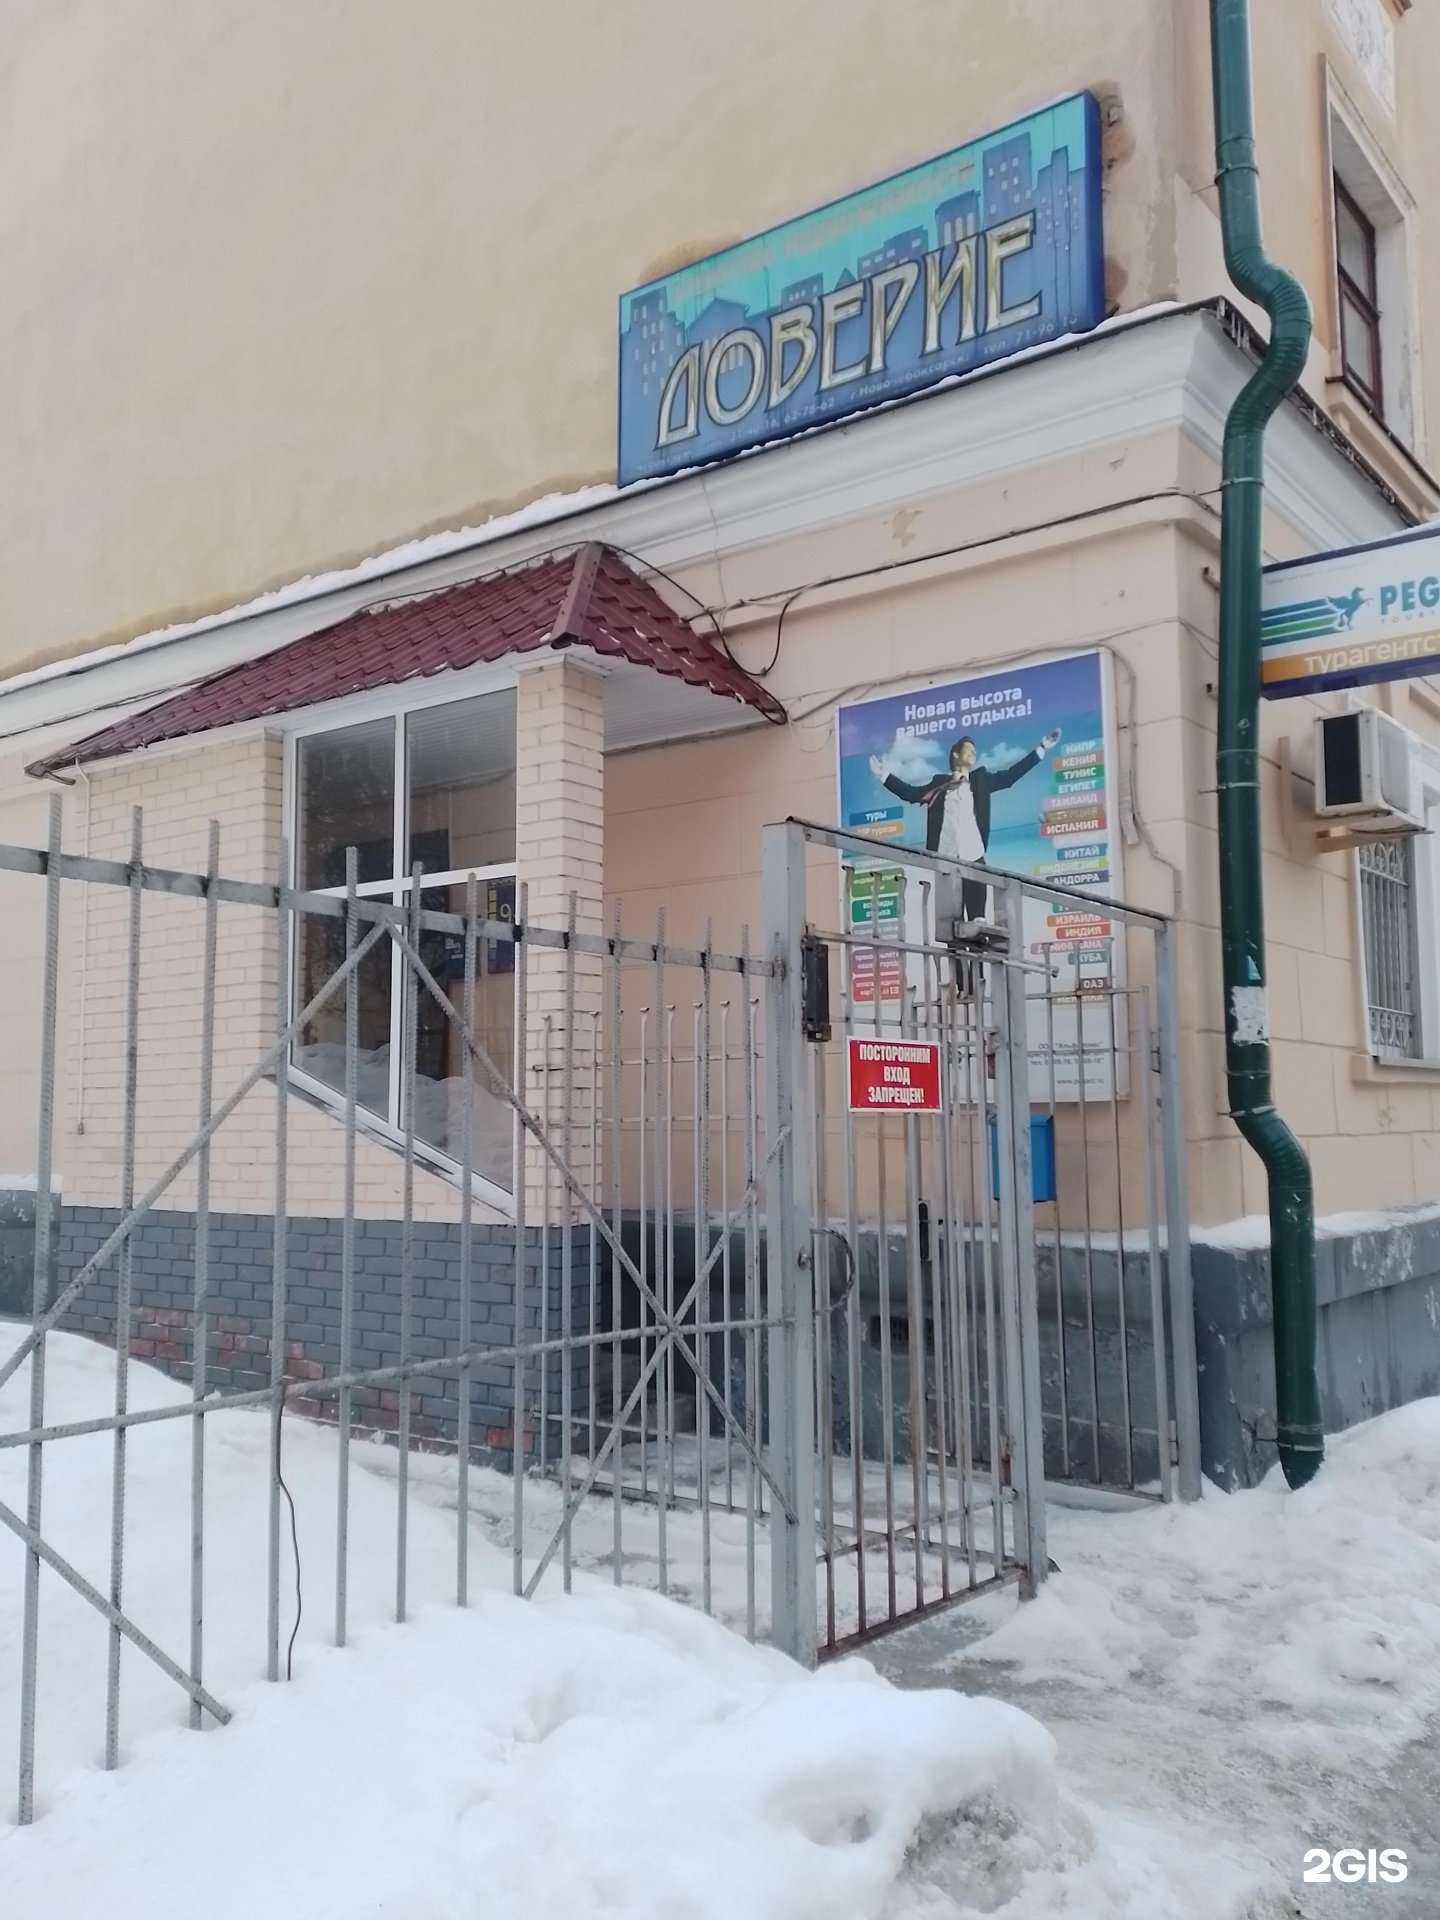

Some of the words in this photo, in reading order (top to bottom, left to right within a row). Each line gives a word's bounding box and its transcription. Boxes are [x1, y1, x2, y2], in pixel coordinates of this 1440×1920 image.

[654, 208, 1042, 451] ДОВЕРИЕ
[904, 700, 956, 721] Новая
[961, 687, 1022, 711] высота
[896, 717, 956, 740] вашего
[961, 698, 1033, 727] отдыха!
[1062, 753, 1097, 767] КЕНИЯ
[1063, 767, 1097, 780] ТУНИС
[1058, 780, 1097, 794] ЕГИПЕТ
[1046, 820, 1099, 834] ИСПАНИЯ
[1064, 845, 1100, 859] КИТАЙ
[1053, 872, 1101, 885] АНДОРРА
[1065, 926, 1102, 938] ИНДИЯ
[859, 1043, 931, 1064] ПОСТОРОННИМ
[883, 1066, 911, 1086] ВХОД
[868, 1086, 925, 1106] ЗАПРЕЩЕН!
